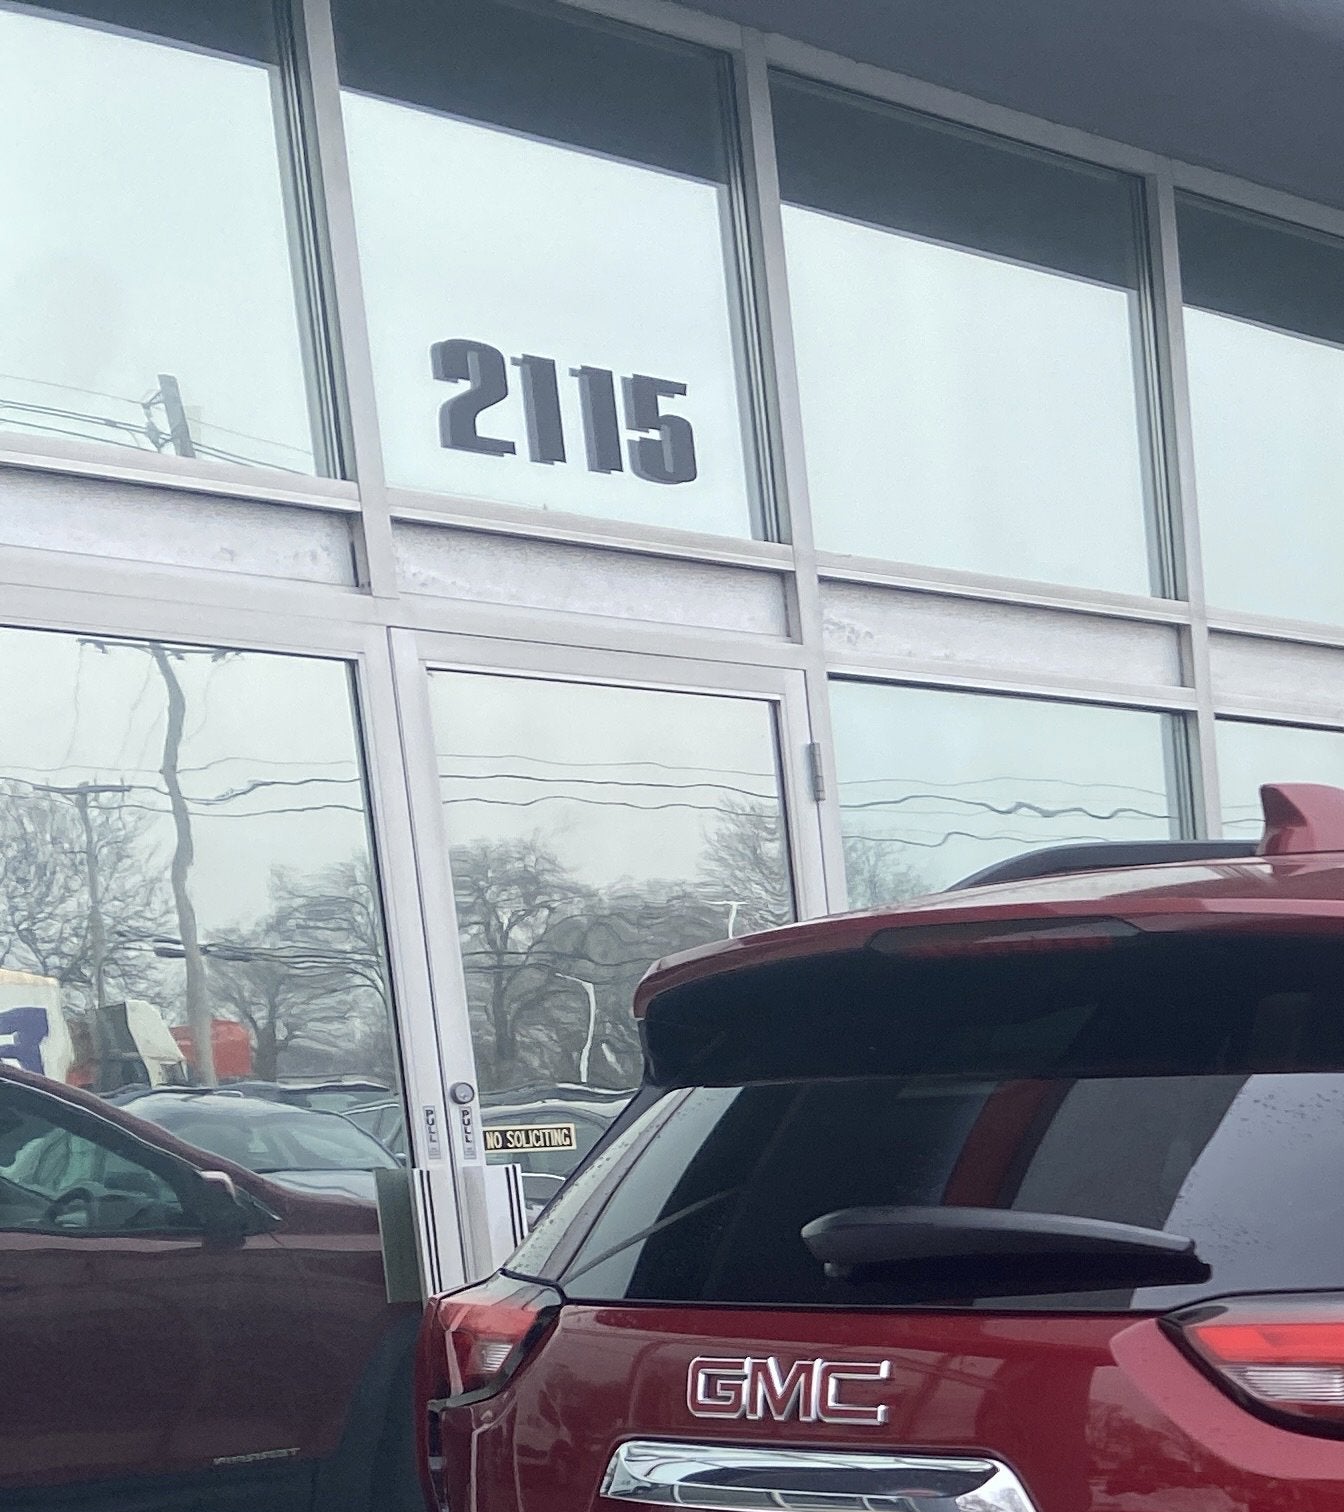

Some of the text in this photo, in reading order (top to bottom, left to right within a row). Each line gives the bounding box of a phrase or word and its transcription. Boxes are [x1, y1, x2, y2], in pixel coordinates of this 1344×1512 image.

[429, 338, 698, 485] 2115
[425, 1109, 437, 1143] PULL
[461, 1109, 472, 1144] PULL
[486, 1129, 571, 1150] NO SOLICITING
[687, 1356, 891, 1425] GMC
